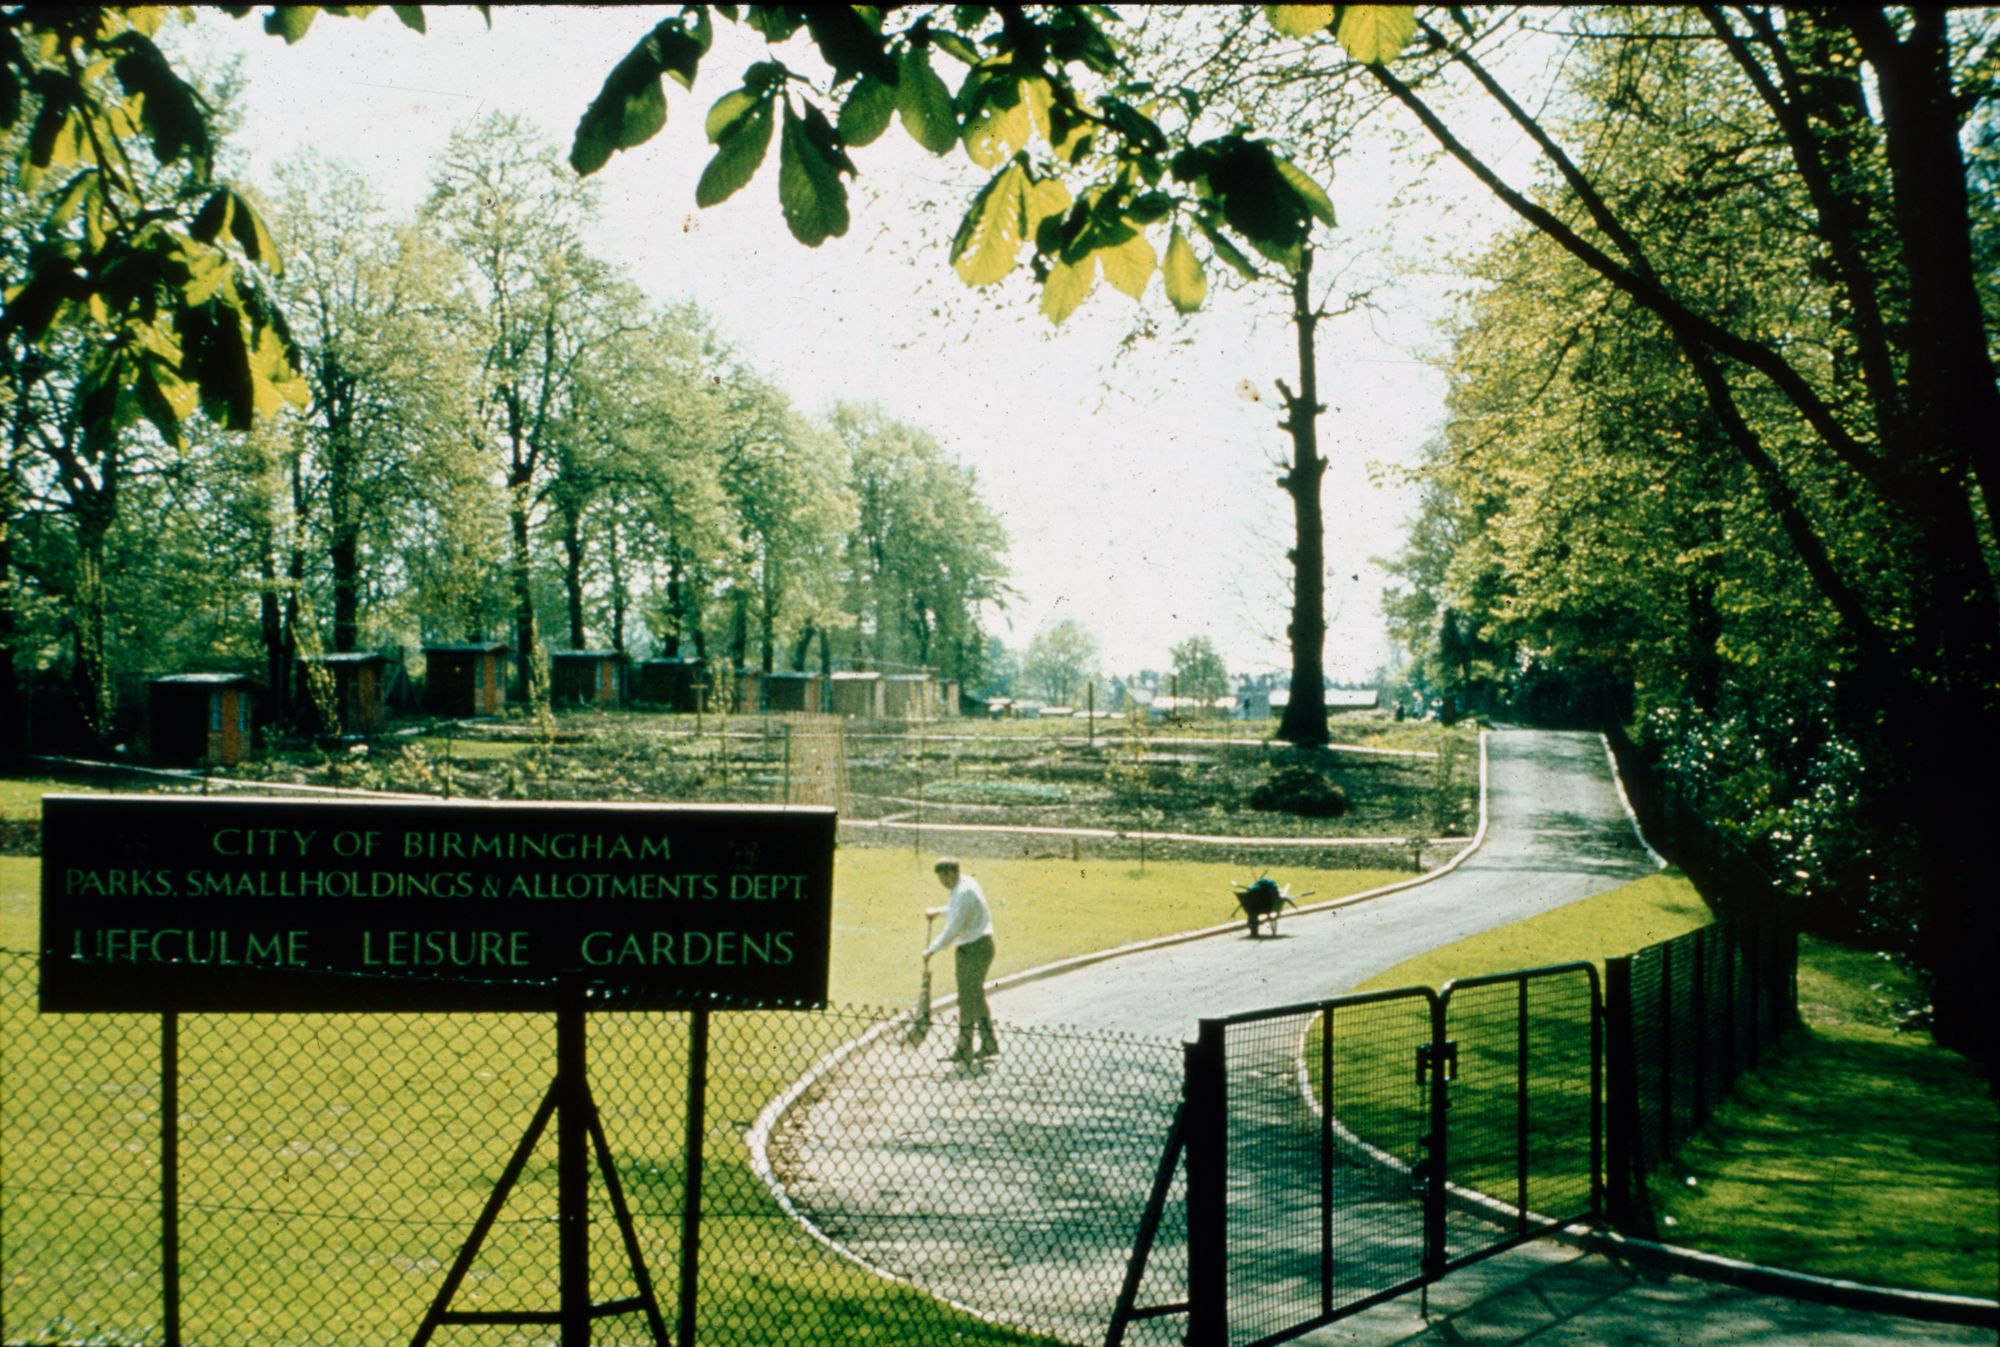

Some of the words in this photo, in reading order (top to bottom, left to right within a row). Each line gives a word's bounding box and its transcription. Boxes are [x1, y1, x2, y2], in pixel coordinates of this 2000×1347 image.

[212, 829, 317, 855] CITY
[332, 831, 381, 857] OF
[403, 832, 671, 860] BIRMINGHAM
[186, 871, 474, 898] SMALLHOLDINGS
[481, 875, 500, 898] &
[507, 873, 720, 899] ALLOTMENTS
[73, 928, 309, 965] UFFCULME
[363, 930, 529, 966] LEISURE
[580, 931, 794, 966] GARDENS
